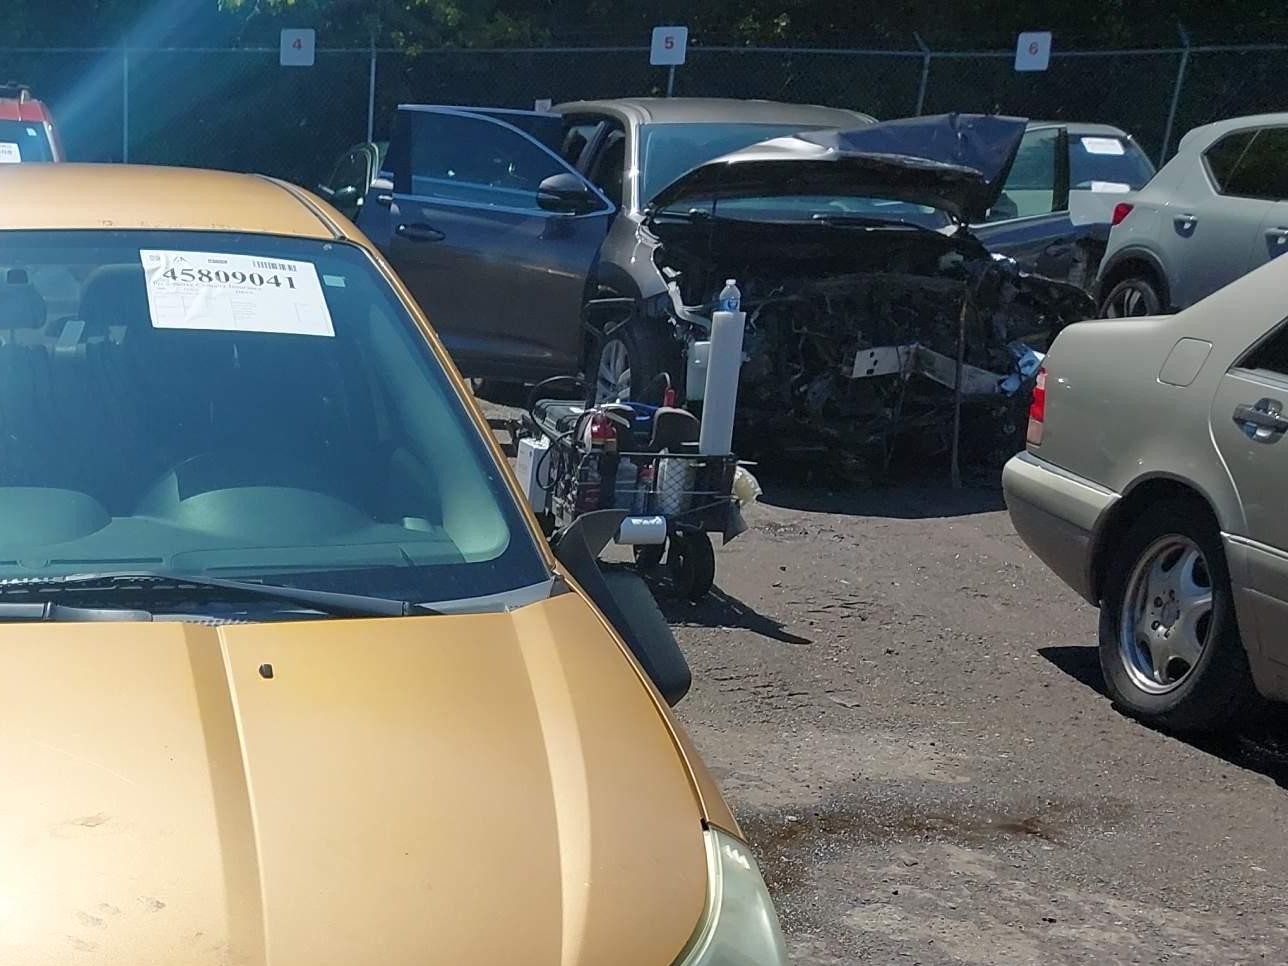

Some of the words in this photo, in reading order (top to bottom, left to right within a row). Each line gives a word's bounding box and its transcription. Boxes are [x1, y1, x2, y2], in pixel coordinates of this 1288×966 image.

[291, 38, 303, 50] 4
[664, 36, 675, 50] 5
[1027, 41, 1039, 55] 6
[162, 267, 297, 290] 45809041
